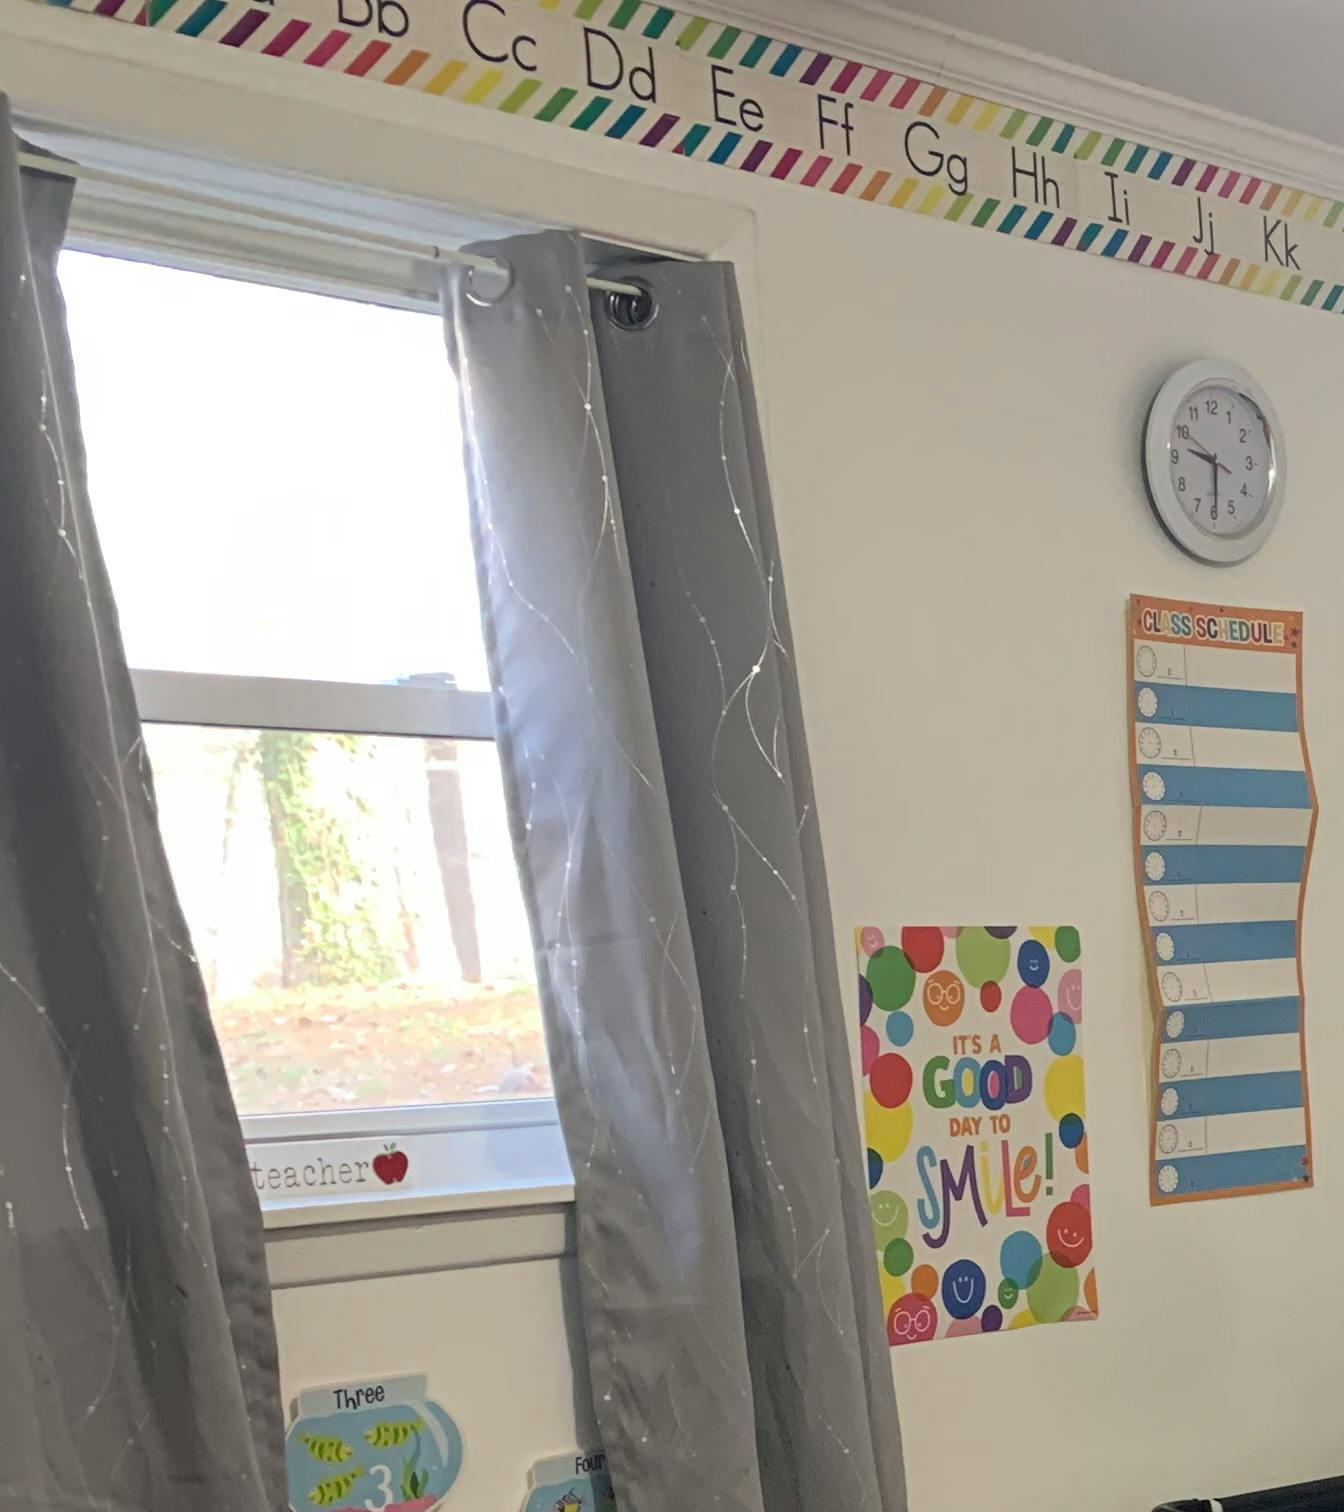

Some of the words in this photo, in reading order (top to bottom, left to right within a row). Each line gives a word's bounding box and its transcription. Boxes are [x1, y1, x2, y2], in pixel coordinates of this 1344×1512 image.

[461, 0, 538, 72] Cc
[582, 26, 657, 103] Dd
[711, 65, 764, 133] Ee
[816, 93, 855, 156] Ff
[903, 121, 969, 196] Gg
[1011, 146, 1061, 209] Hh
[1104, 171, 1130, 226] Ii
[1192, 196, 1215, 256] Jj
[1262, 214, 1301, 271] Kk
[1189, 406, 1199, 421] 11
[1204, 400, 1219, 415] 12
[1226, 410, 1232, 424] 1
[1176, 424, 1190, 440] 10
[1239, 428, 1247, 443] 2
[1171, 449, 1179, 464] 9
[1245, 455, 1254, 471] 3
[1178, 476, 1186, 492] 8
[1240, 483, 1248, 497] 4
[1194, 498, 1202, 513] 7
[1210, 505, 1218, 520] 6
[1227, 500, 1235, 515] 5
[1143, 608, 1192, 636] CLASS
[1196, 615, 1285, 645] SCHEDULE
[952, 1034, 983, 1055] IT'S
[989, 1034, 1001, 1054] A
[922, 1055, 1033, 1111] GOOD
[949, 1115, 982, 1137] DAY
[989, 1113, 1011, 1134] TO
[249, 1157, 369, 1191] teacher
[333, 1385, 385, 1410] Three
[575, 1454, 606, 1475] Four
[364, 1464, 393, 1512] 3
